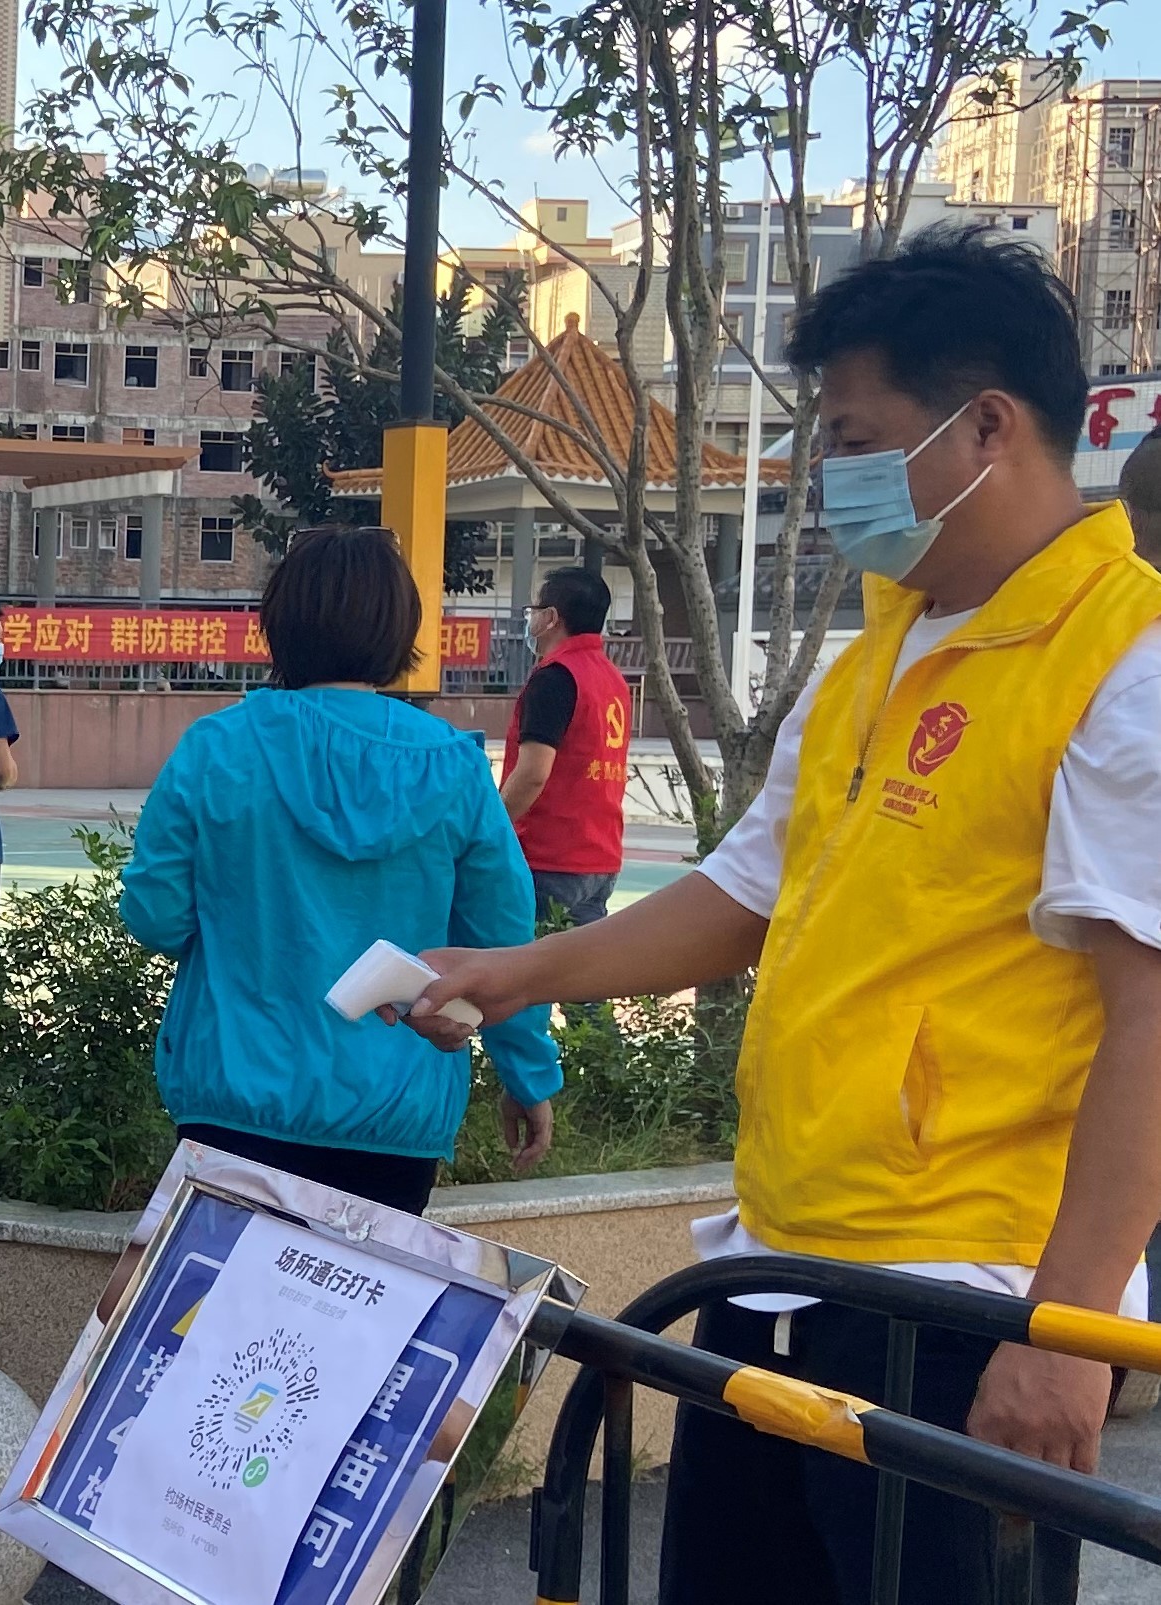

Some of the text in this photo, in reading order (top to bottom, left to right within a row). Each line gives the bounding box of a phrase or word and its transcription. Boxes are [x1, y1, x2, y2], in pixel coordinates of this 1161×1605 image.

[110, 616, 228, 655] 群防群控
[275, 1245, 386, 1306] 场所通行打卡
